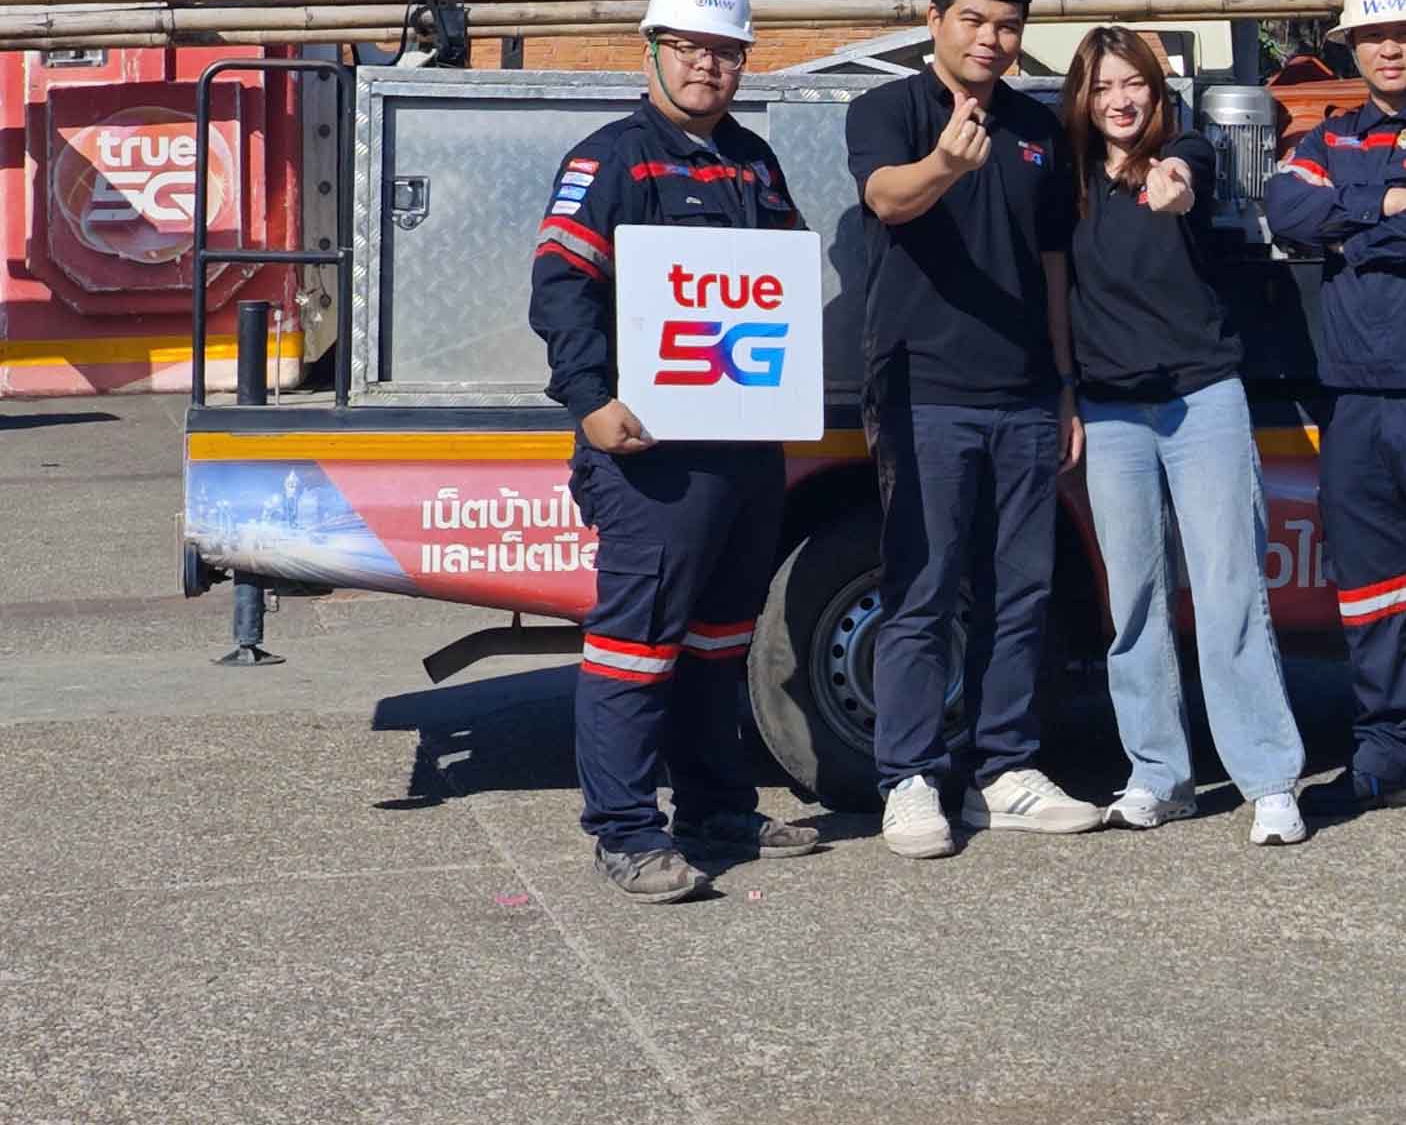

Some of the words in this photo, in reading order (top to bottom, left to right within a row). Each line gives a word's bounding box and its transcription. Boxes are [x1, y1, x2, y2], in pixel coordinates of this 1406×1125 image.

[97, 131, 197, 167] true
[88, 171, 197, 221] 5G
[668, 263, 784, 310] true
[654, 320, 789, 387] 5G
